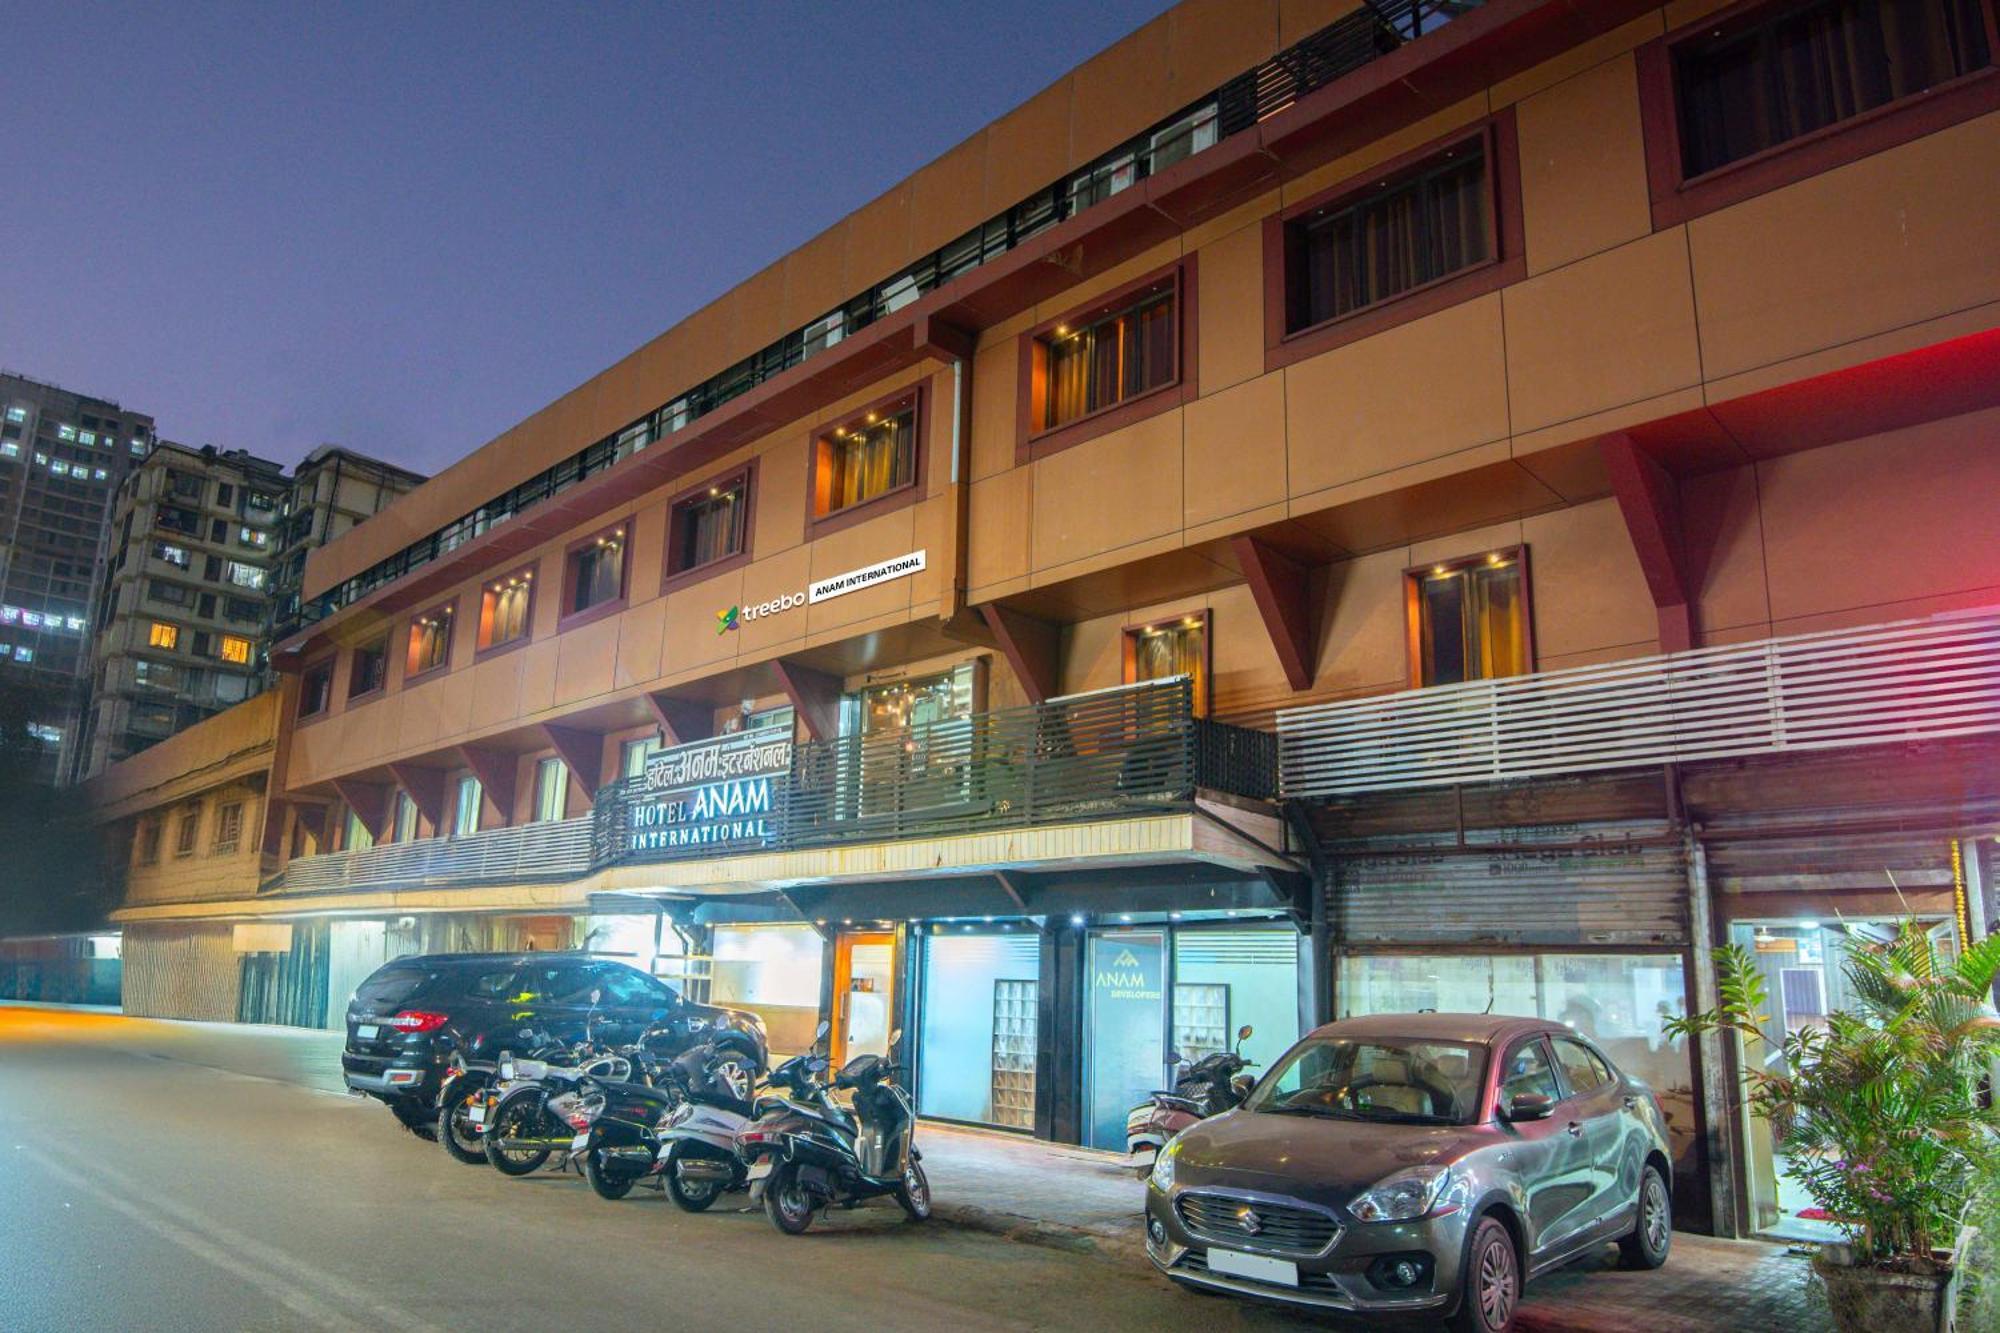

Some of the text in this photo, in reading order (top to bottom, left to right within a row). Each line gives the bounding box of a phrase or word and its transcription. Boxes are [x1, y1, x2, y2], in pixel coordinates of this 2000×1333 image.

[815, 557, 921, 597] ANAM INTERNATIONAL
[743, 592, 805, 621] treebo
[634, 776, 769, 827] HOTEL ANAM
[632, 820, 768, 850] INTERNATIONAL
[1095, 971, 1145, 988] ANAM
